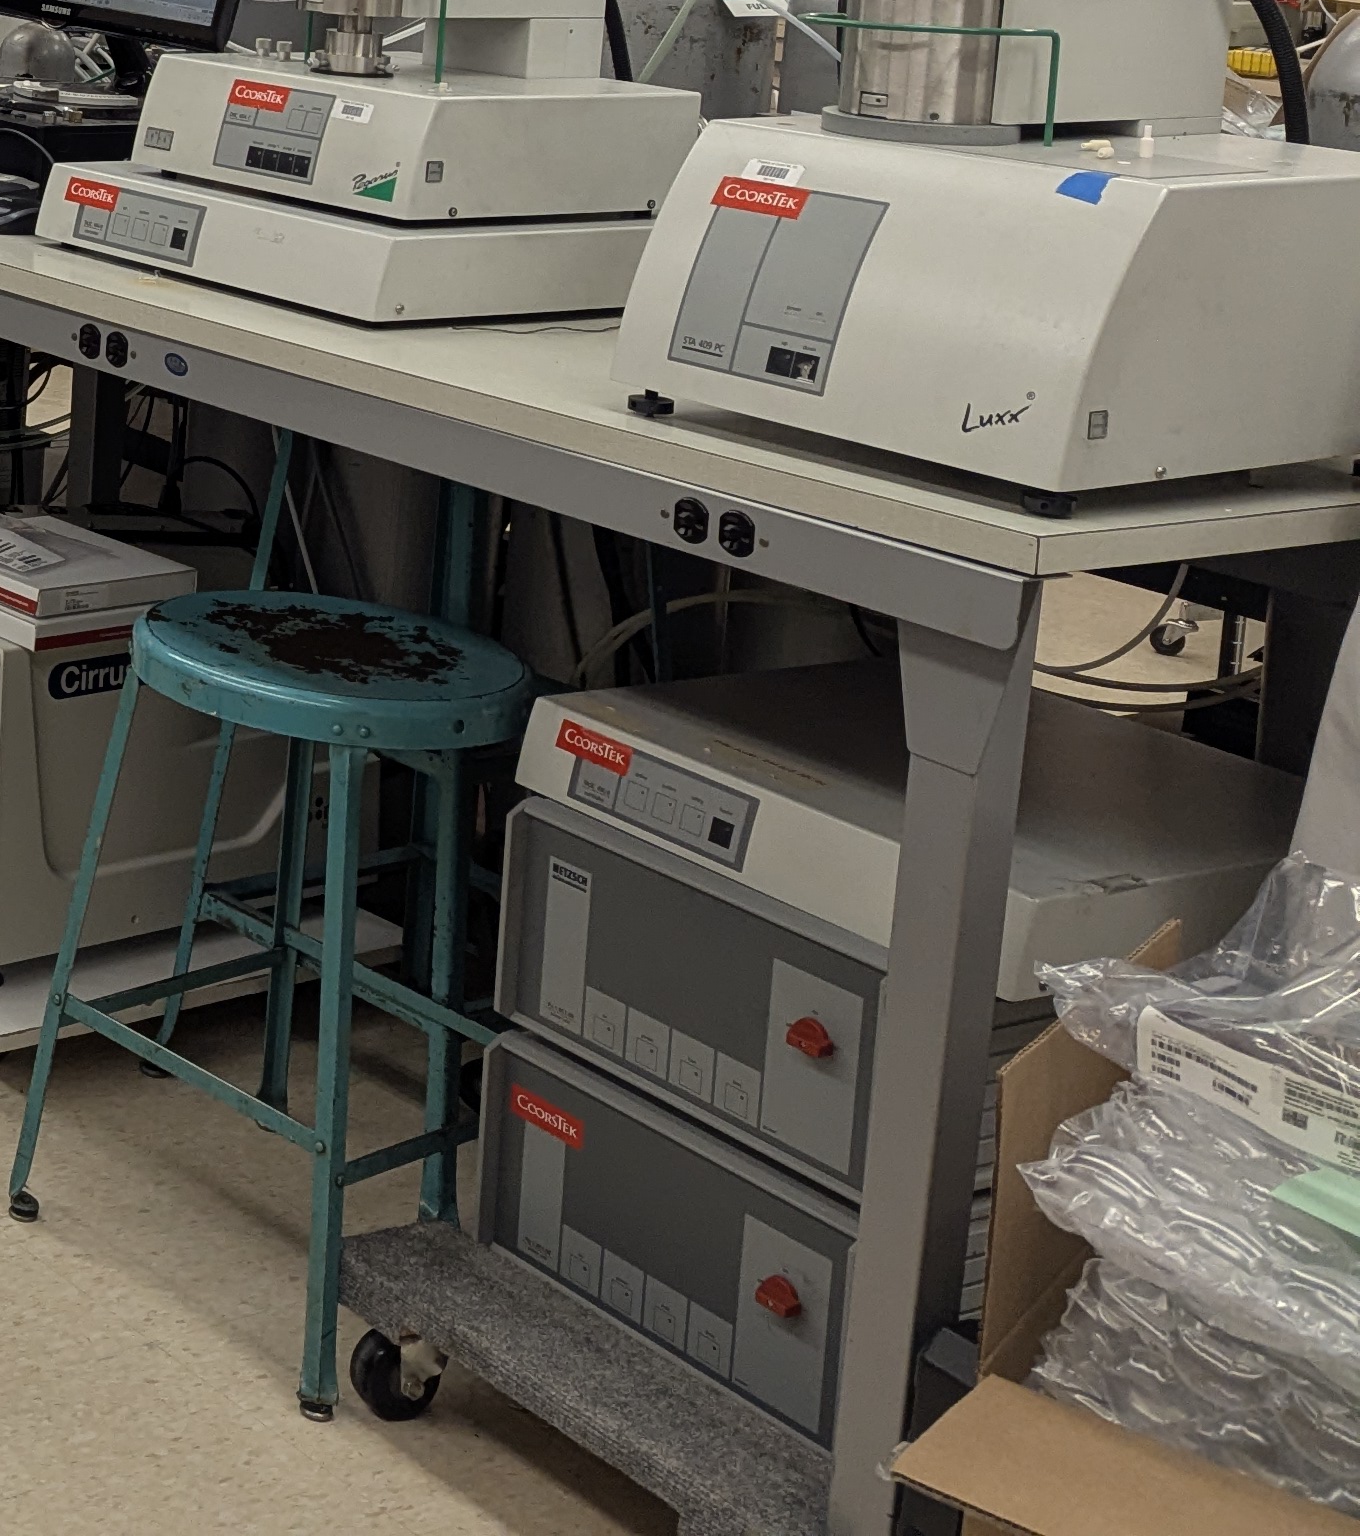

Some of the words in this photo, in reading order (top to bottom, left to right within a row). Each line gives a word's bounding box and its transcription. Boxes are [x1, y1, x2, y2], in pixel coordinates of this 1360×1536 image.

[41, 4, 72, 16] SAMSUNG
[352, 170, 399, 192] Pegasus
[683, 335, 697, 347] STA
[698, 338, 713, 350] 409
[713, 342, 726, 353] PC
[552, 862, 588, 887] NETZSCH
